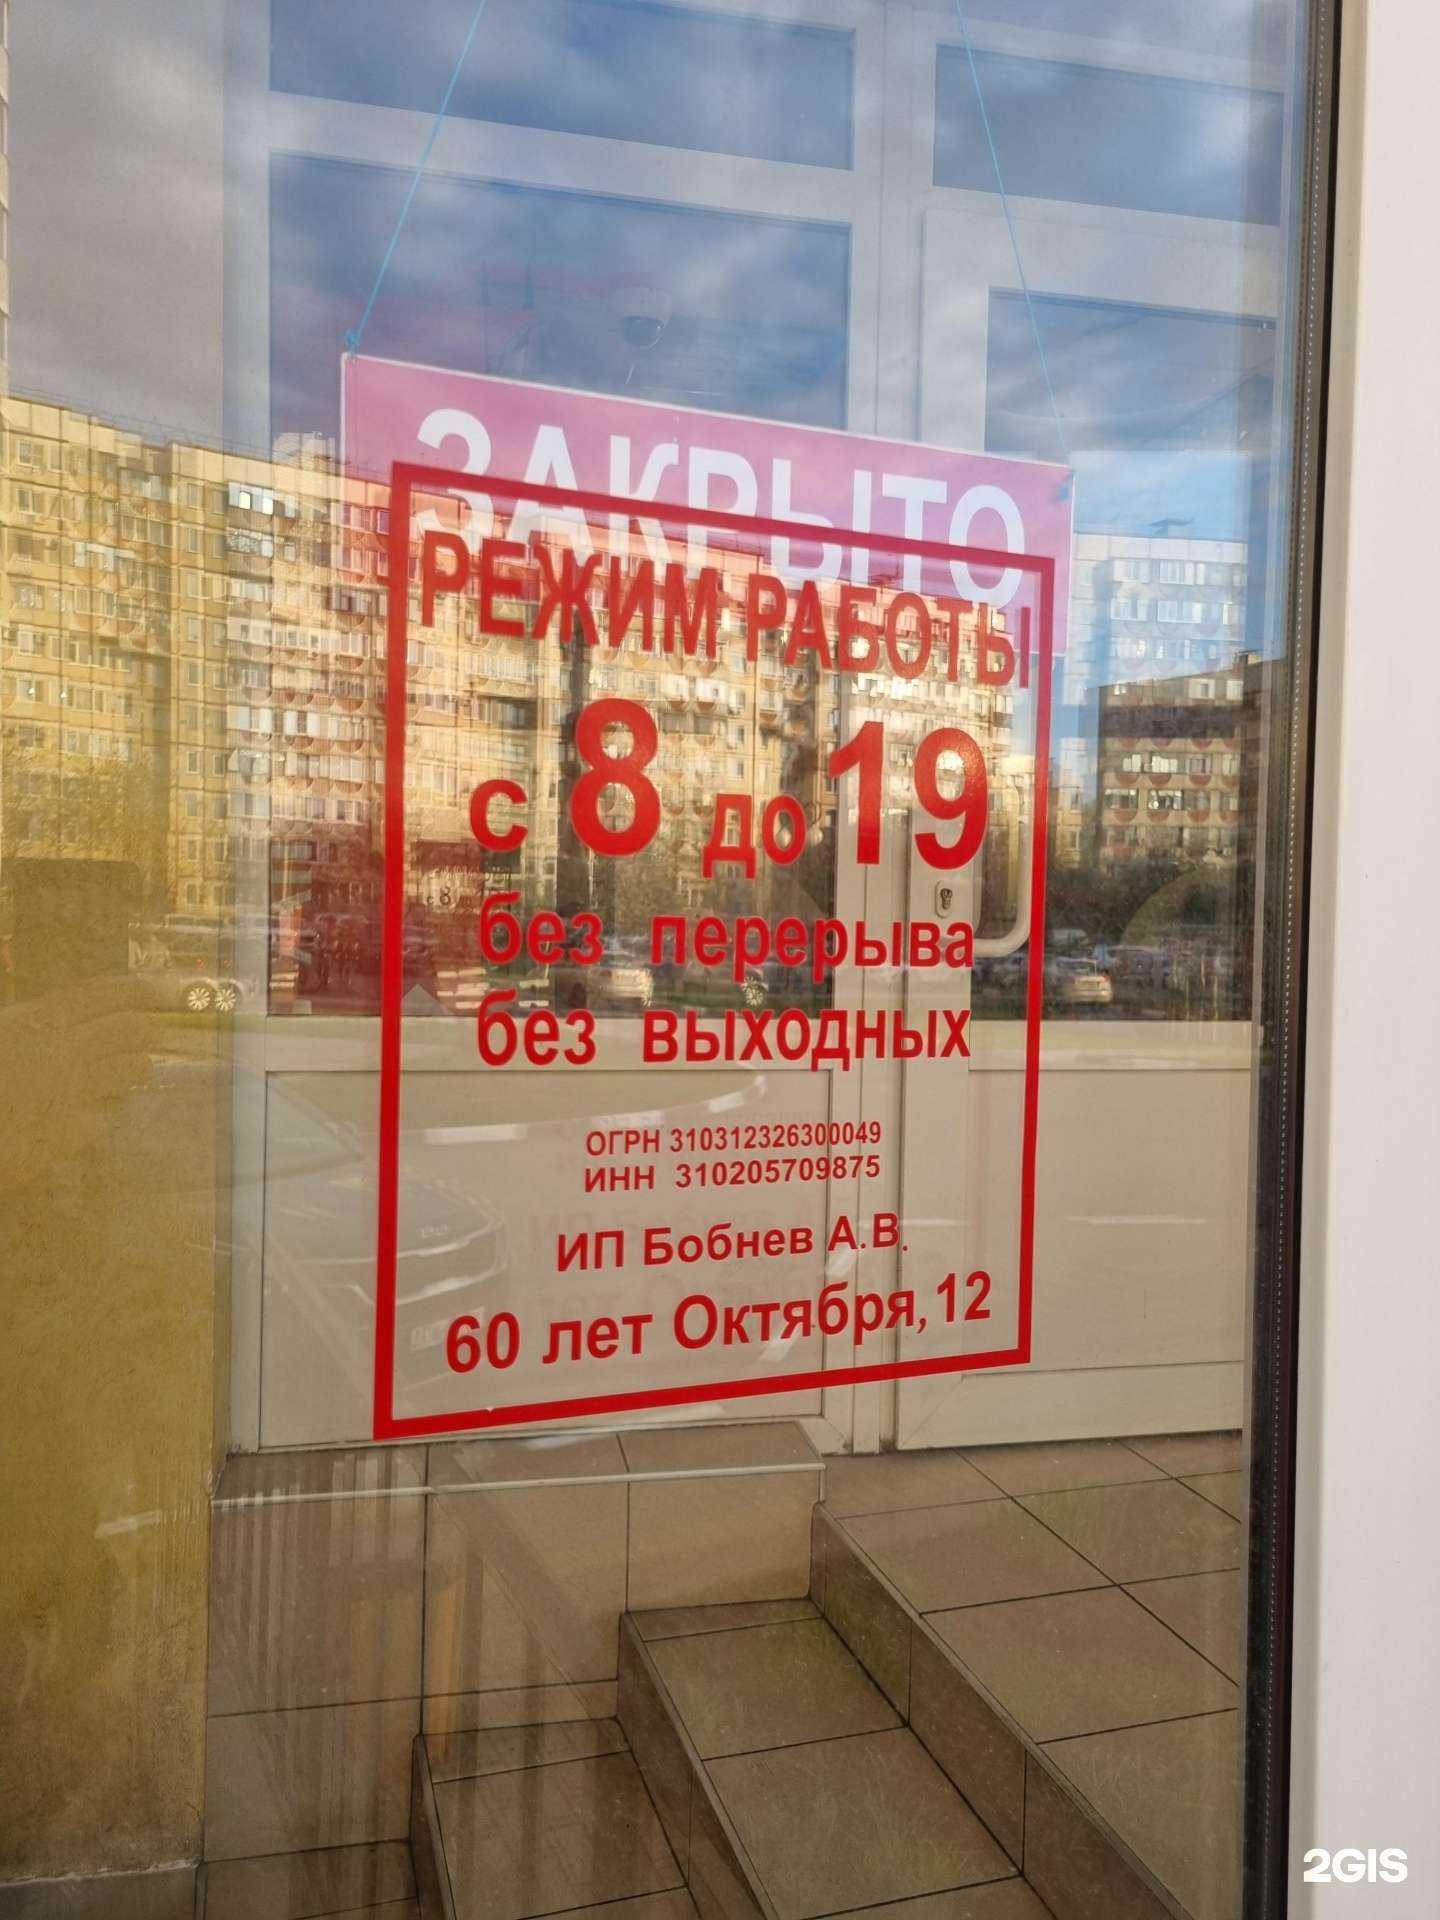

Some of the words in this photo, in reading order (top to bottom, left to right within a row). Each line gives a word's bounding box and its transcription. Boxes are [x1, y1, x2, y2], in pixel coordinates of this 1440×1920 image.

[415, 408, 1026, 609] ЗАКРЫТО
[420, 529, 720, 658] РЕЖИМ
[746, 573, 1030, 689] РАБОТЫ
[569, 696, 661, 857] 8
[701, 794, 807, 880] до
[828, 722, 989, 871] 19
[478, 891, 604, 966] без
[652, 915, 974, 983] перерыва
[477, 989, 596, 1067] без
[642, 1008, 971, 1072] выходных
[584, 1167, 655, 1192] ИНН
[675, 1155, 880, 1188] 310205709875
[587, 1130, 660, 1156] ОГРН
[669, 1121, 882, 1153] 310312326300049
[556, 1230, 624, 1272] ИП
[643, 1223, 813, 1267] Бобнев
[828, 1212, 908, 1253] А.В.
[445, 1312, 520, 1373] 60
[543, 1314, 653, 1365] лет
